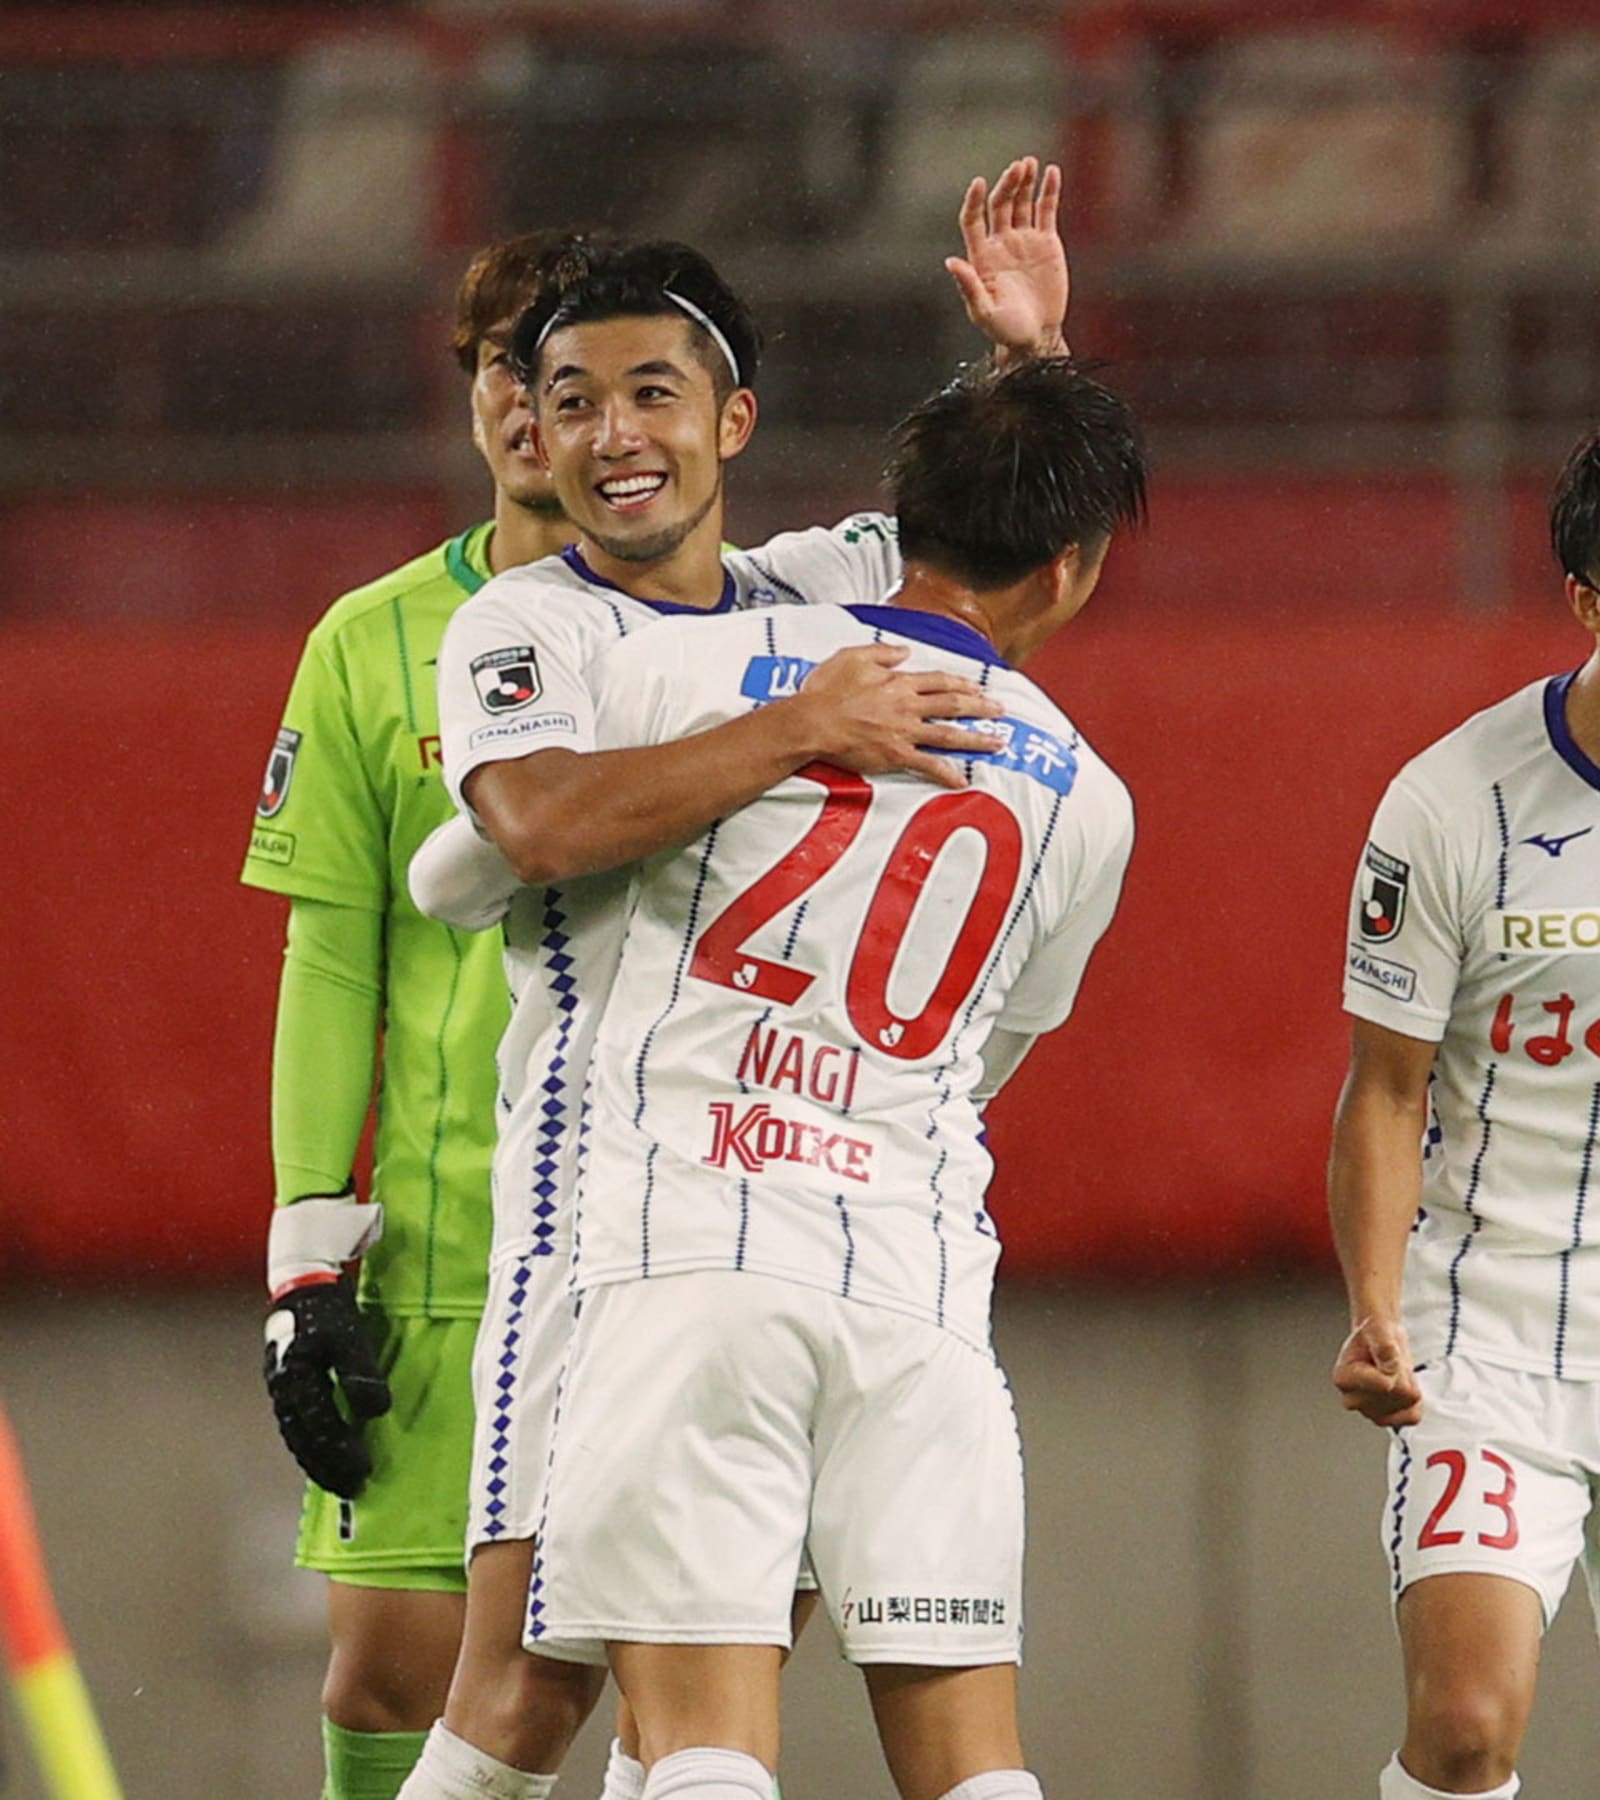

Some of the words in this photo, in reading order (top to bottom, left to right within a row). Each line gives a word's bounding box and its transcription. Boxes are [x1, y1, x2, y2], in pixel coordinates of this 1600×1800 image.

[688, 760, 1023, 1060] 20
[737, 1023, 860, 1109] NAGI
[1417, 1448, 1520, 1551] 23
[858, 1597, 1005, 1625] 山梨日日新聞社
